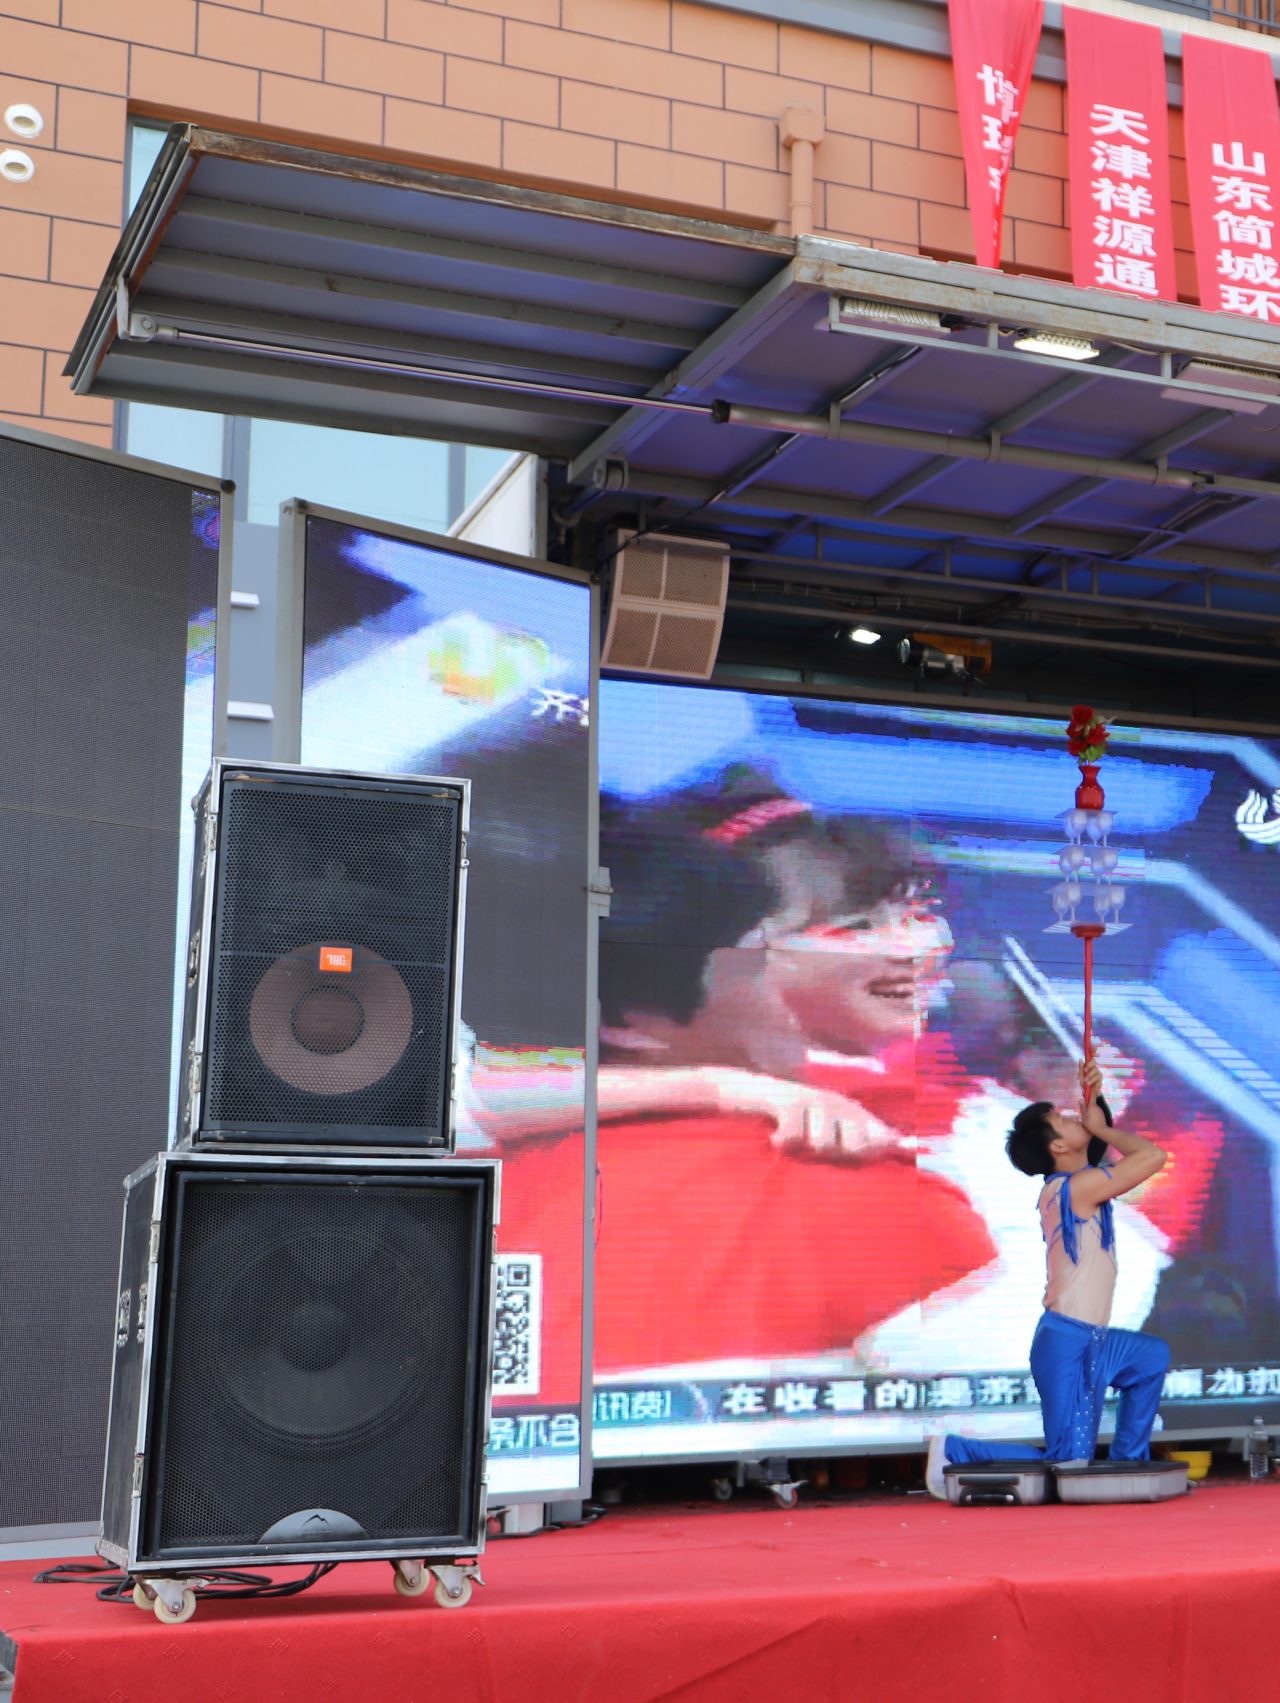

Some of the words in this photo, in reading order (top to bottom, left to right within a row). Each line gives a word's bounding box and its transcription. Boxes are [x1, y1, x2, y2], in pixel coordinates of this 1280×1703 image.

[1090, 103, 1159, 295] 天津祥源通
